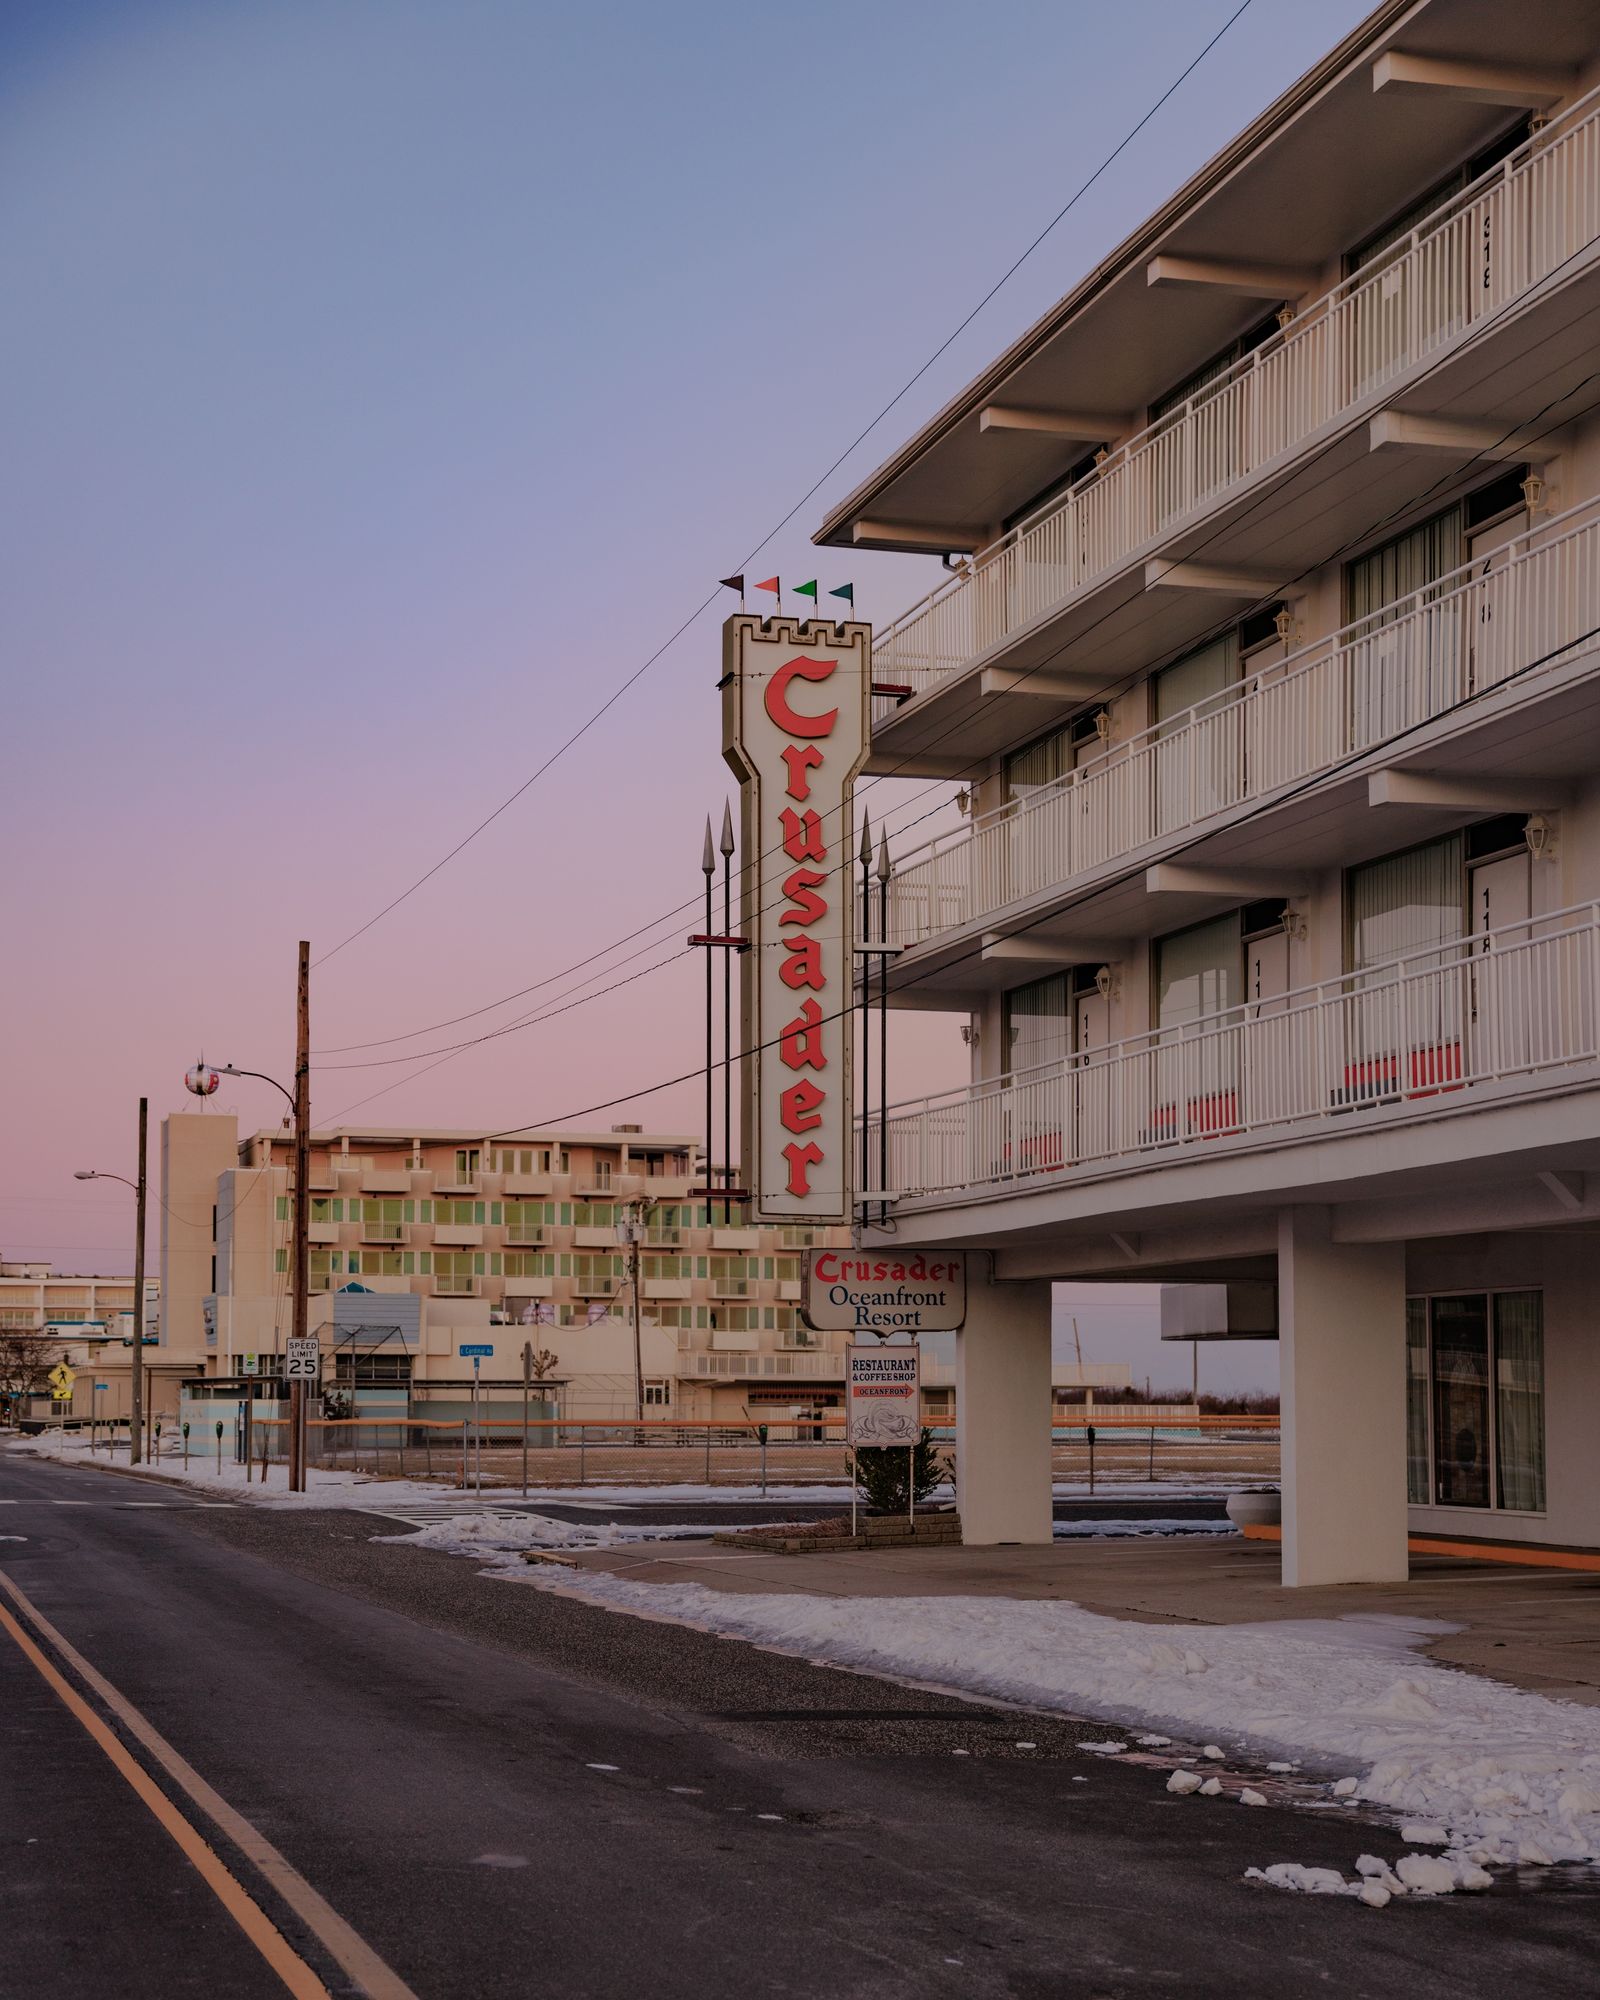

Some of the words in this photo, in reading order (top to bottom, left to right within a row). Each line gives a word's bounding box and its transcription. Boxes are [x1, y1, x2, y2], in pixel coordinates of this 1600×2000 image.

[764, 655, 839, 1198] Crusader
[1482, 887, 1491, 953] 118
[814, 1252, 960, 1284] Crusader
[829, 1285, 947, 1306] Oceanfront
[854, 1306, 921, 1326] Resort
[289, 1342, 317, 1350] SPEED
[289, 1359, 316, 1374] 25
[852, 1359, 916, 1371] RESTAURANT
[852, 1373, 858, 1381] &
[859, 1373, 892, 1381] COFFEE
[893, 1373, 916, 1381] SHOP
[860, 1388, 908, 1396] OCEANFRONT
